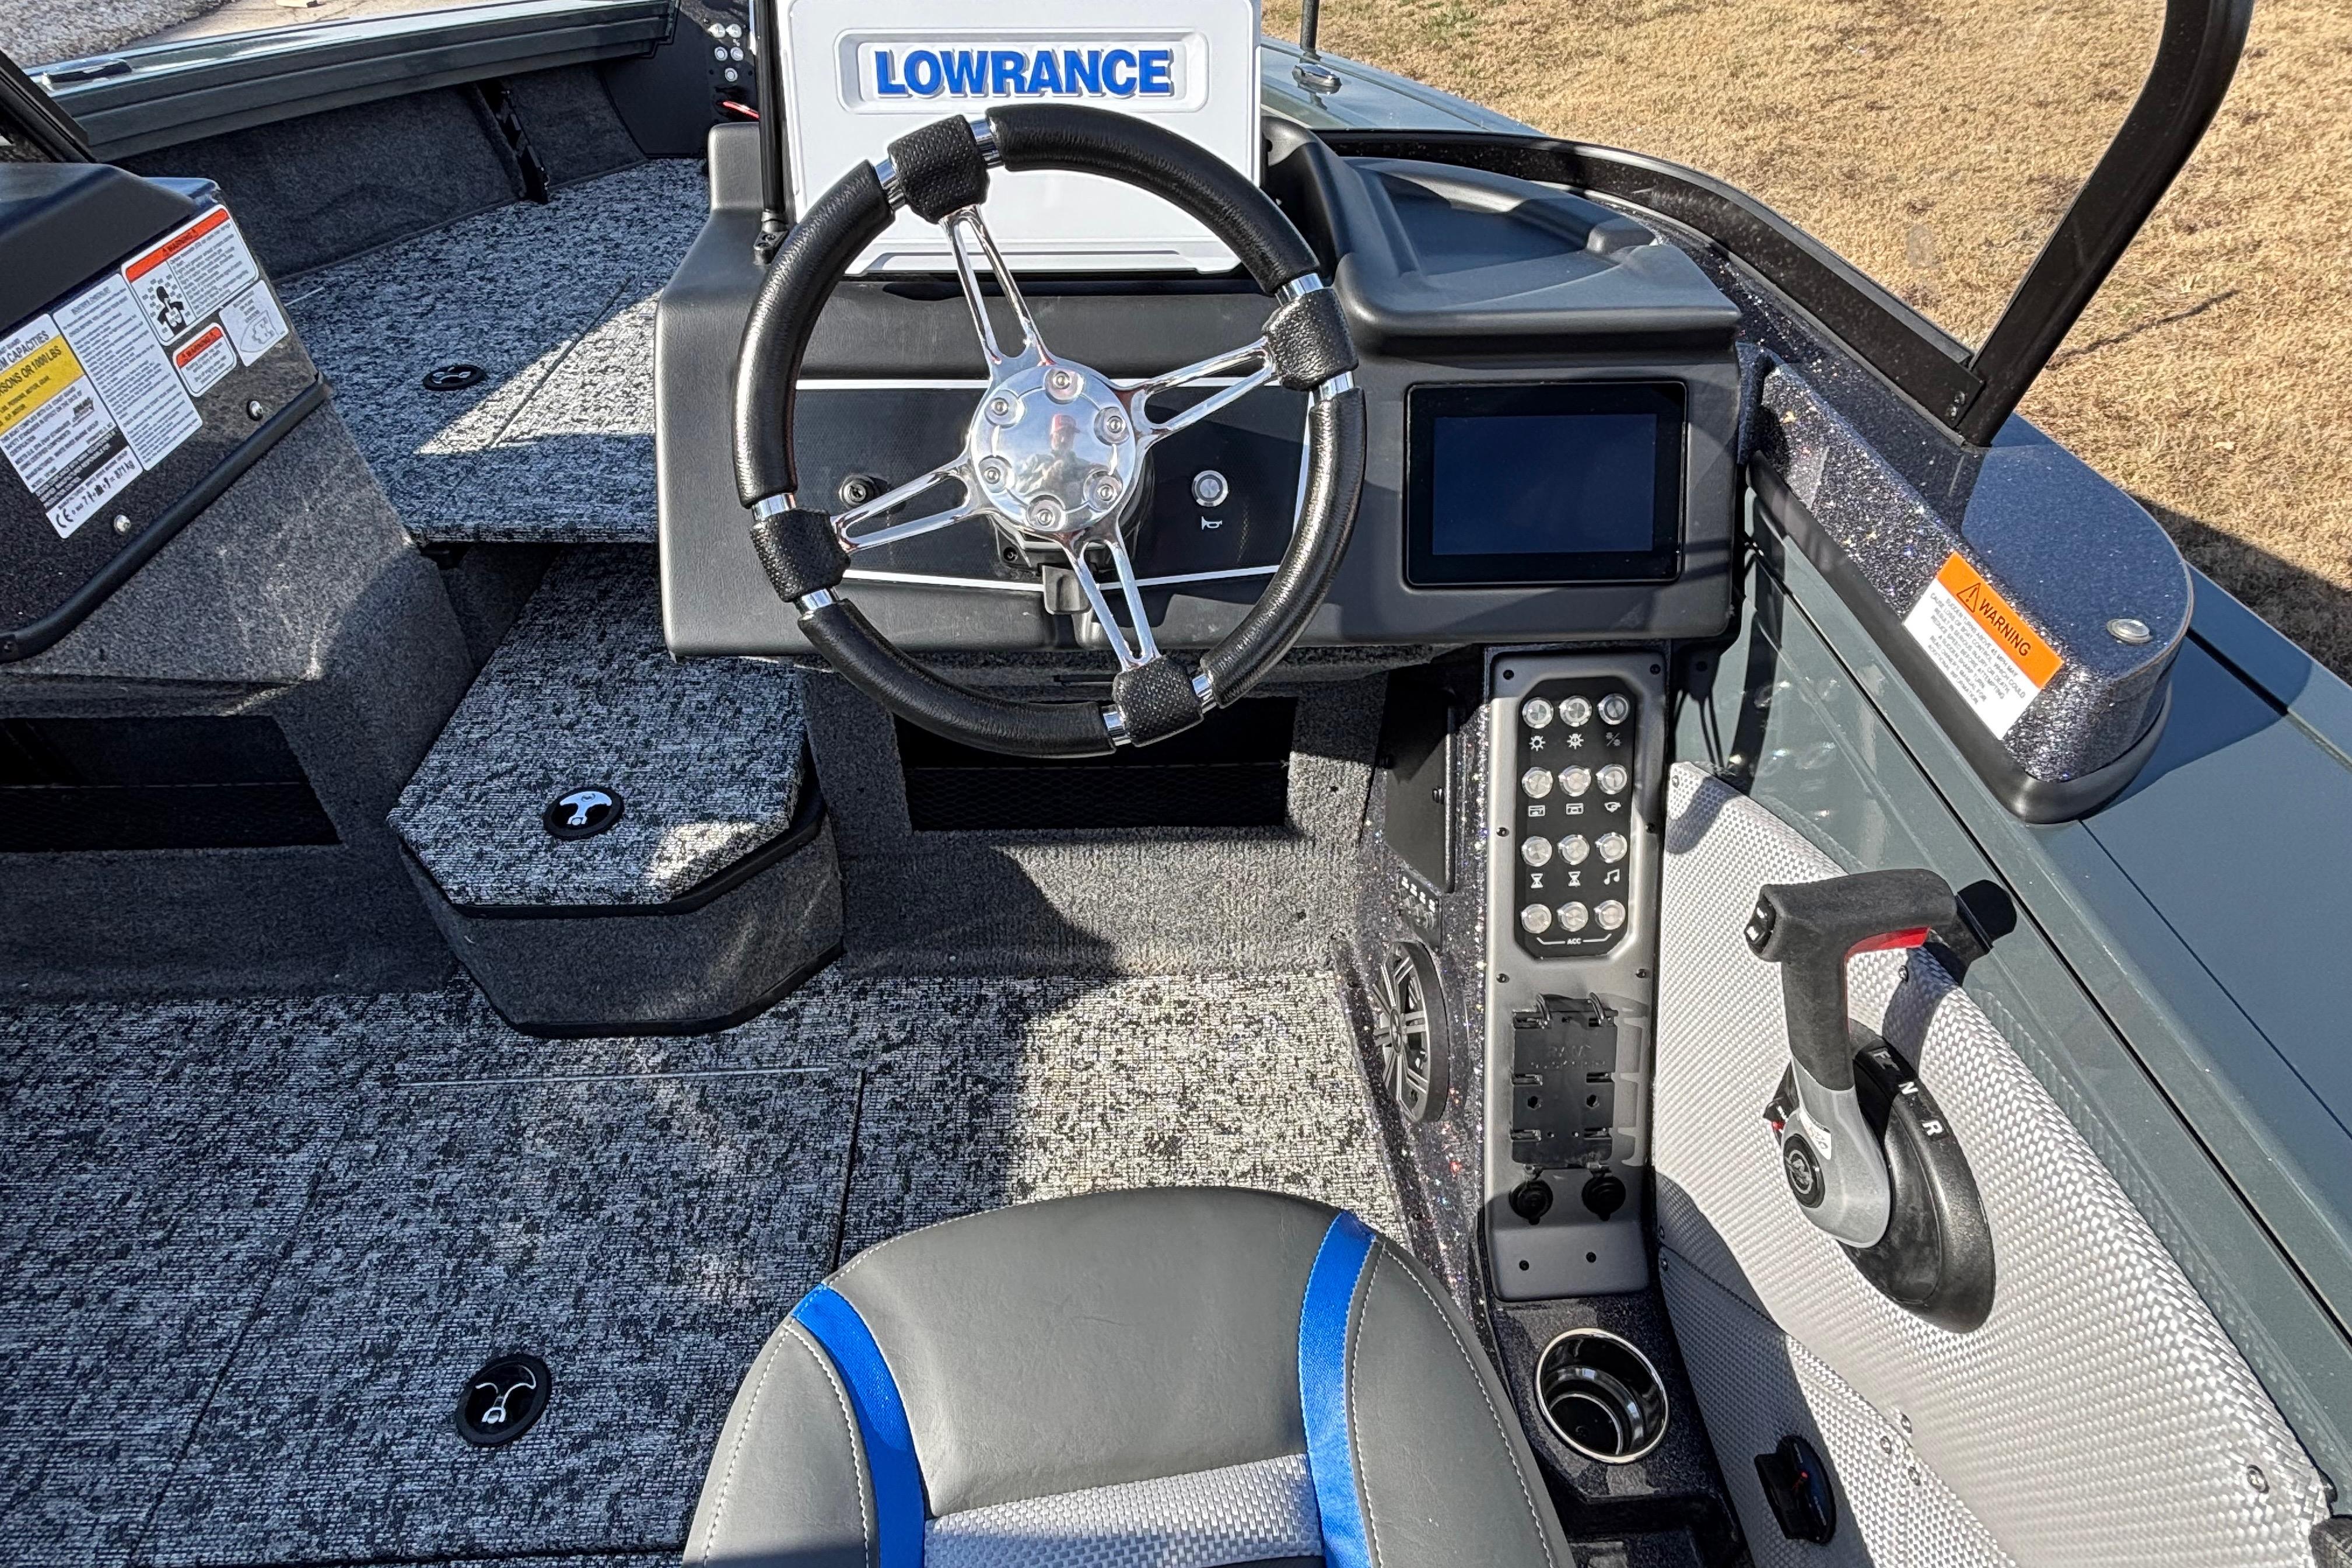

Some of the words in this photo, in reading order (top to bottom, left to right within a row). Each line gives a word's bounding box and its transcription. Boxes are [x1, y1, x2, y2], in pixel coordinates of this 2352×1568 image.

[874, 49, 1170, 96] LOWRANCE
[6, 331, 49, 363] CAPACITIES
[21, 364, 34, 377] OR
[45, 345, 61, 361] LBS
[1979, 598, 2031, 656] WARNING
[1898, 1081, 1919, 1094] N
[1922, 1119, 1943, 1136] R
